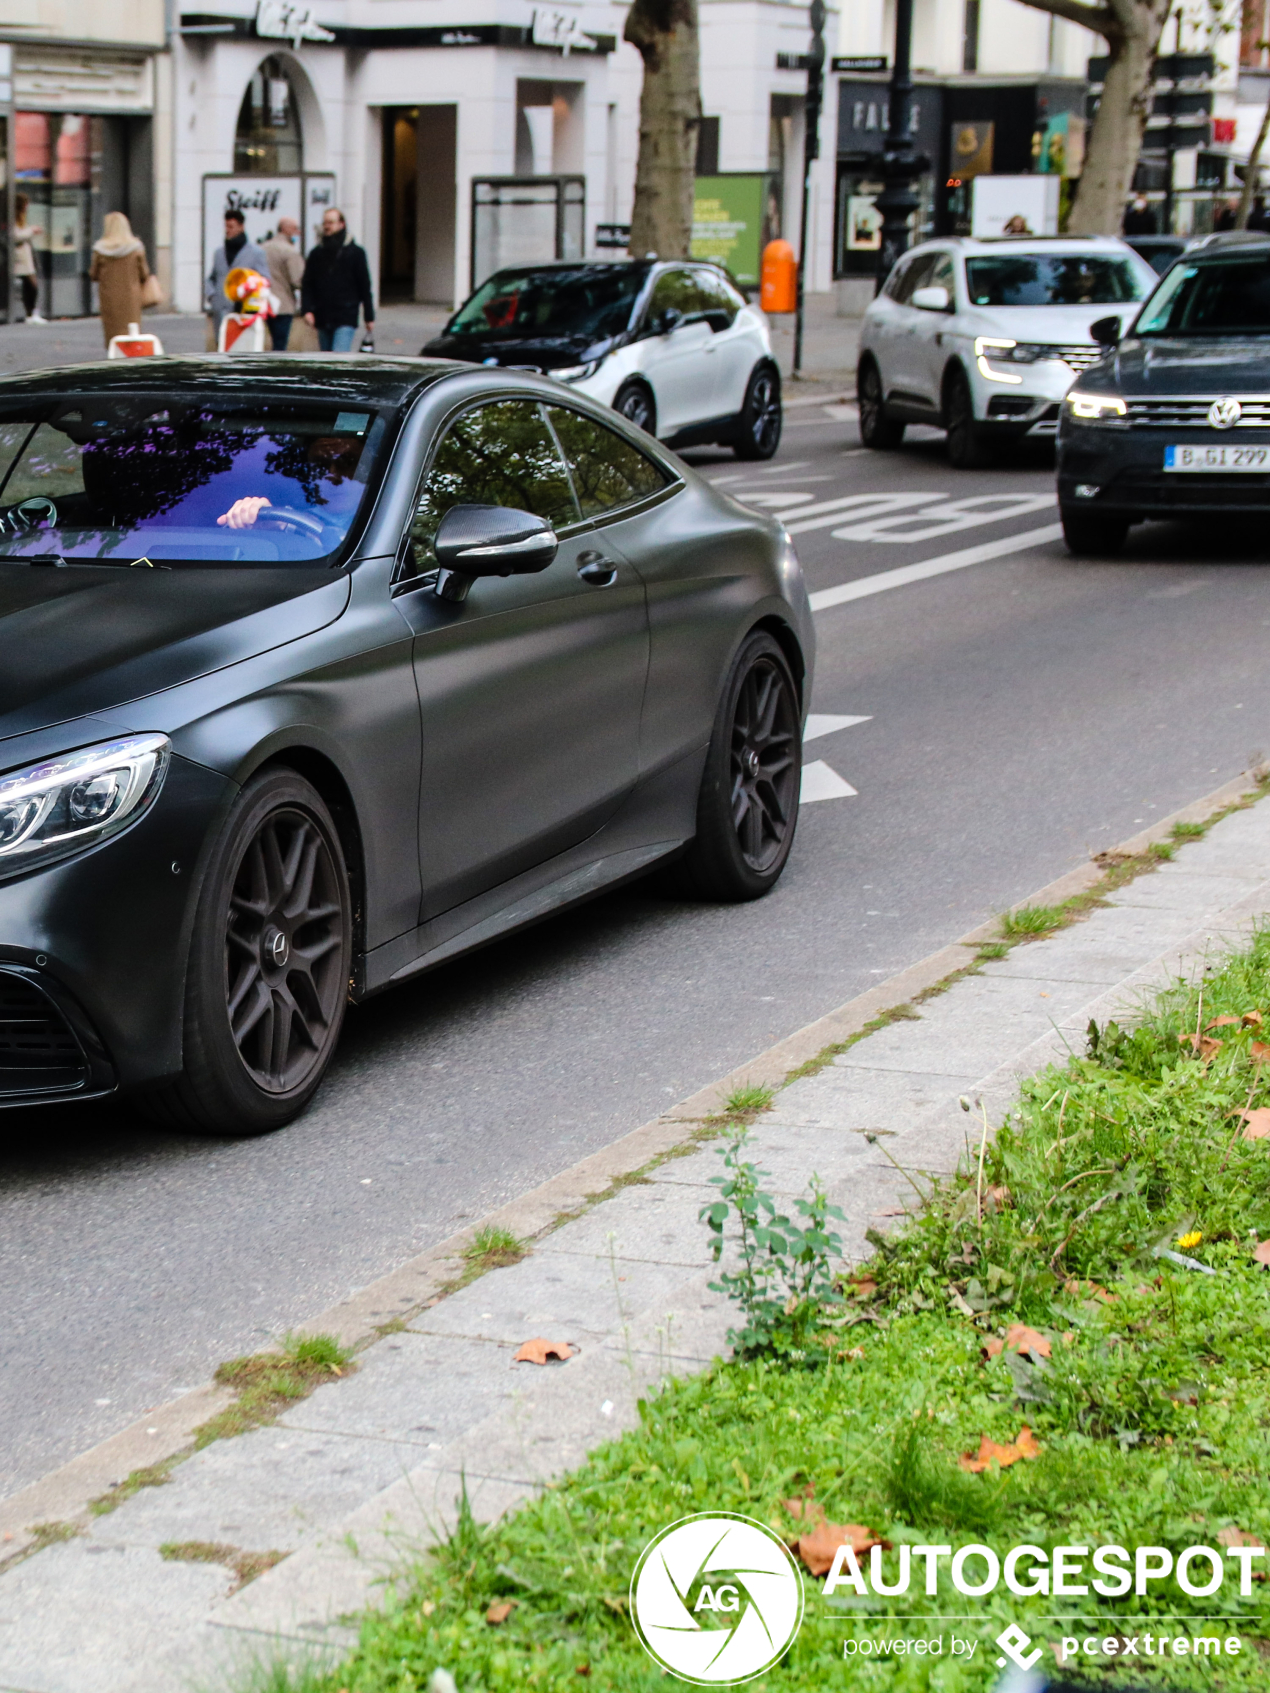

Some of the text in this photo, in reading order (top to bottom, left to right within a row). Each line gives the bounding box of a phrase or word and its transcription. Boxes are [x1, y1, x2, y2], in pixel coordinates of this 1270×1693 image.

[852, 101, 921, 132] FALE
[226, 188, 280, 212] Steiff
[1181, 448, 1194, 467] B
[1232, 448, 1268, 467] 299
